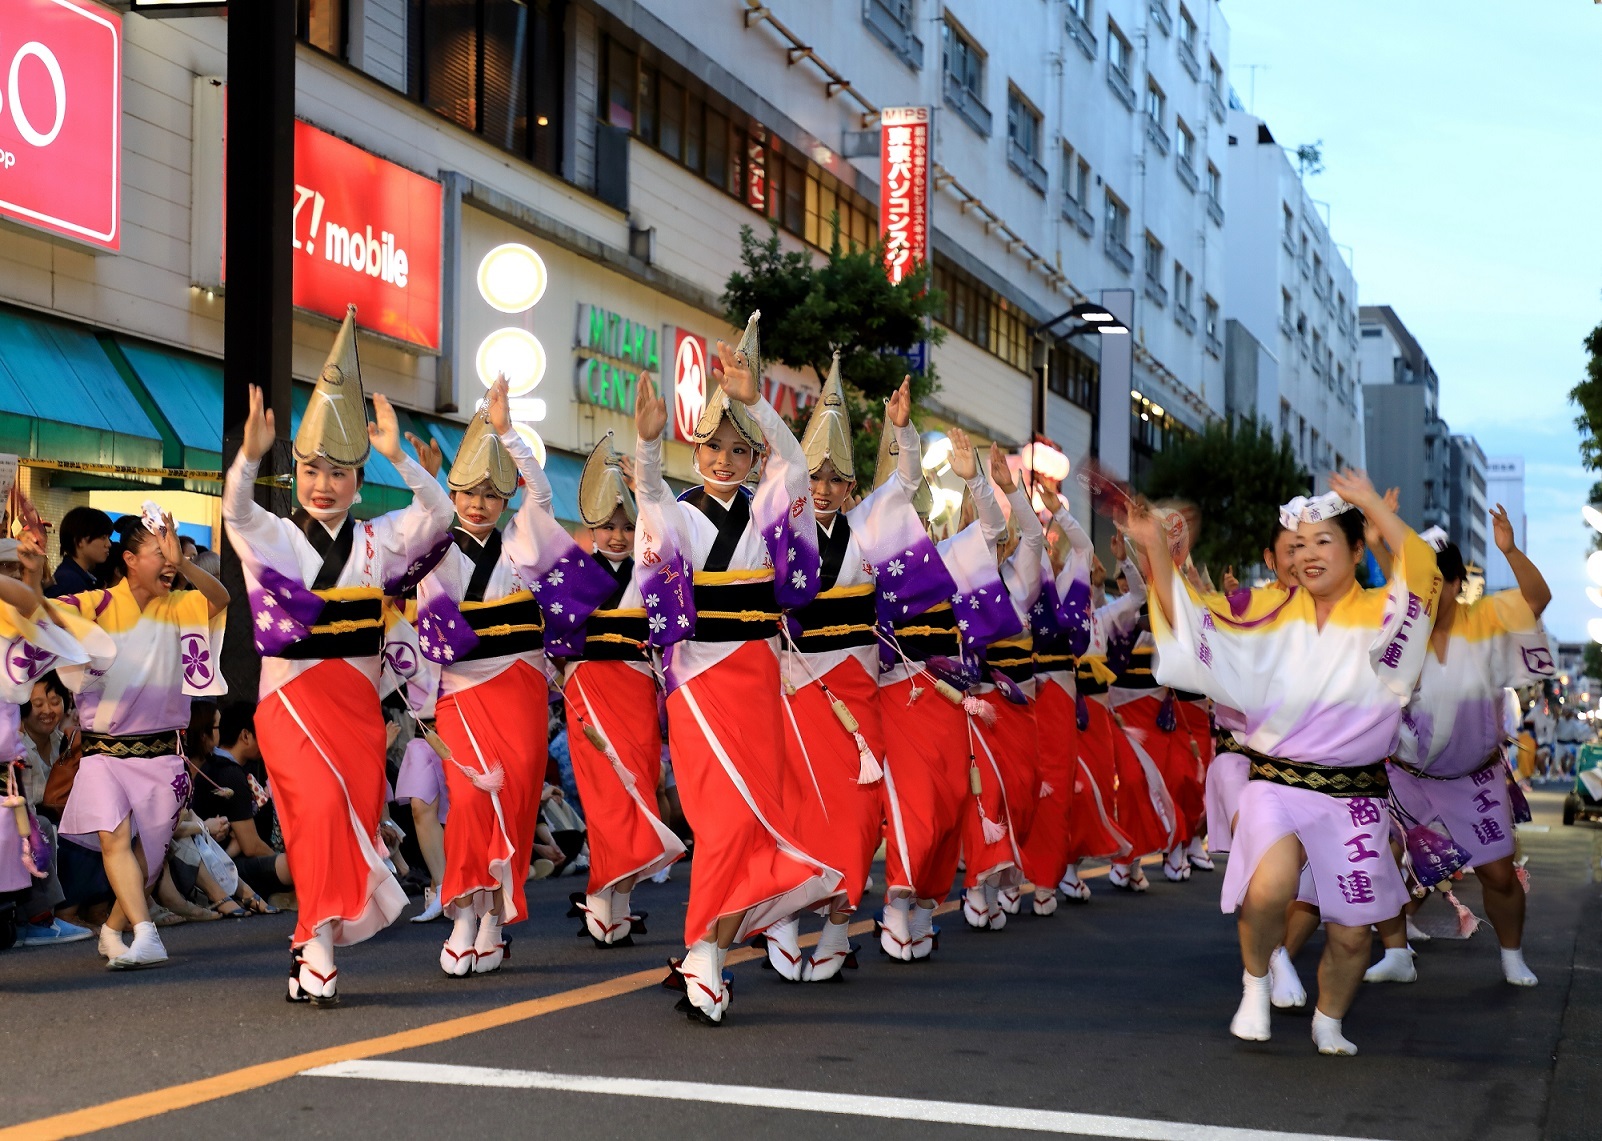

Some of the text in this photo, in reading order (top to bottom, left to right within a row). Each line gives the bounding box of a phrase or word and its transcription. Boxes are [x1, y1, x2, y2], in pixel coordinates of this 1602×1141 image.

[0, 41, 67, 147] O
[885, 108, 927, 120] MIPS
[887, 126, 912, 286] 東京パソコンスクー
[325, 222, 409, 288] mobile
[587, 304, 660, 374] MITAKA
[586, 357, 658, 416] CENT
[1336, 796, 1381, 904] 商工連
